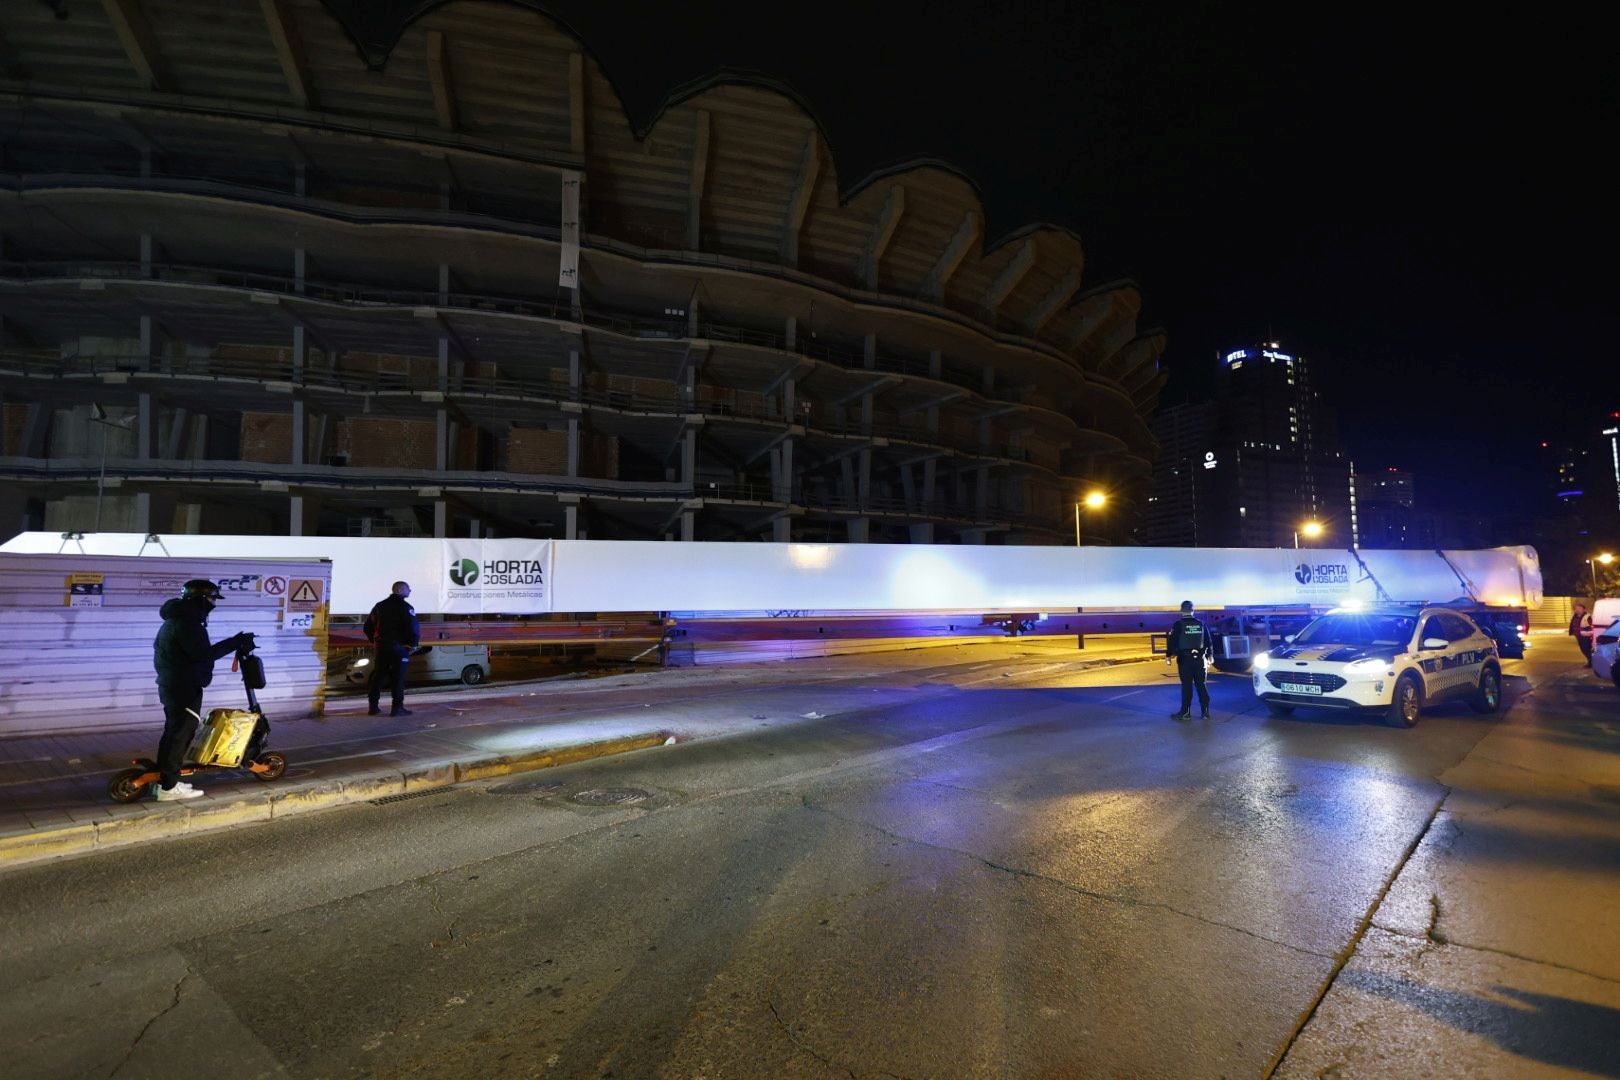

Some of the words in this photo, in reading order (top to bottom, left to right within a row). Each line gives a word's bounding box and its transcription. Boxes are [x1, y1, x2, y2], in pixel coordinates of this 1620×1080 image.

[483, 560, 543, 574] HORTA
[1312, 564, 1347, 575] HORTA
[483, 574, 543, 585] COSLADA
[1313, 575, 1348, 583] COSLADA
[217, 579, 250, 591] FCC
[291, 618, 311, 627] FCC
